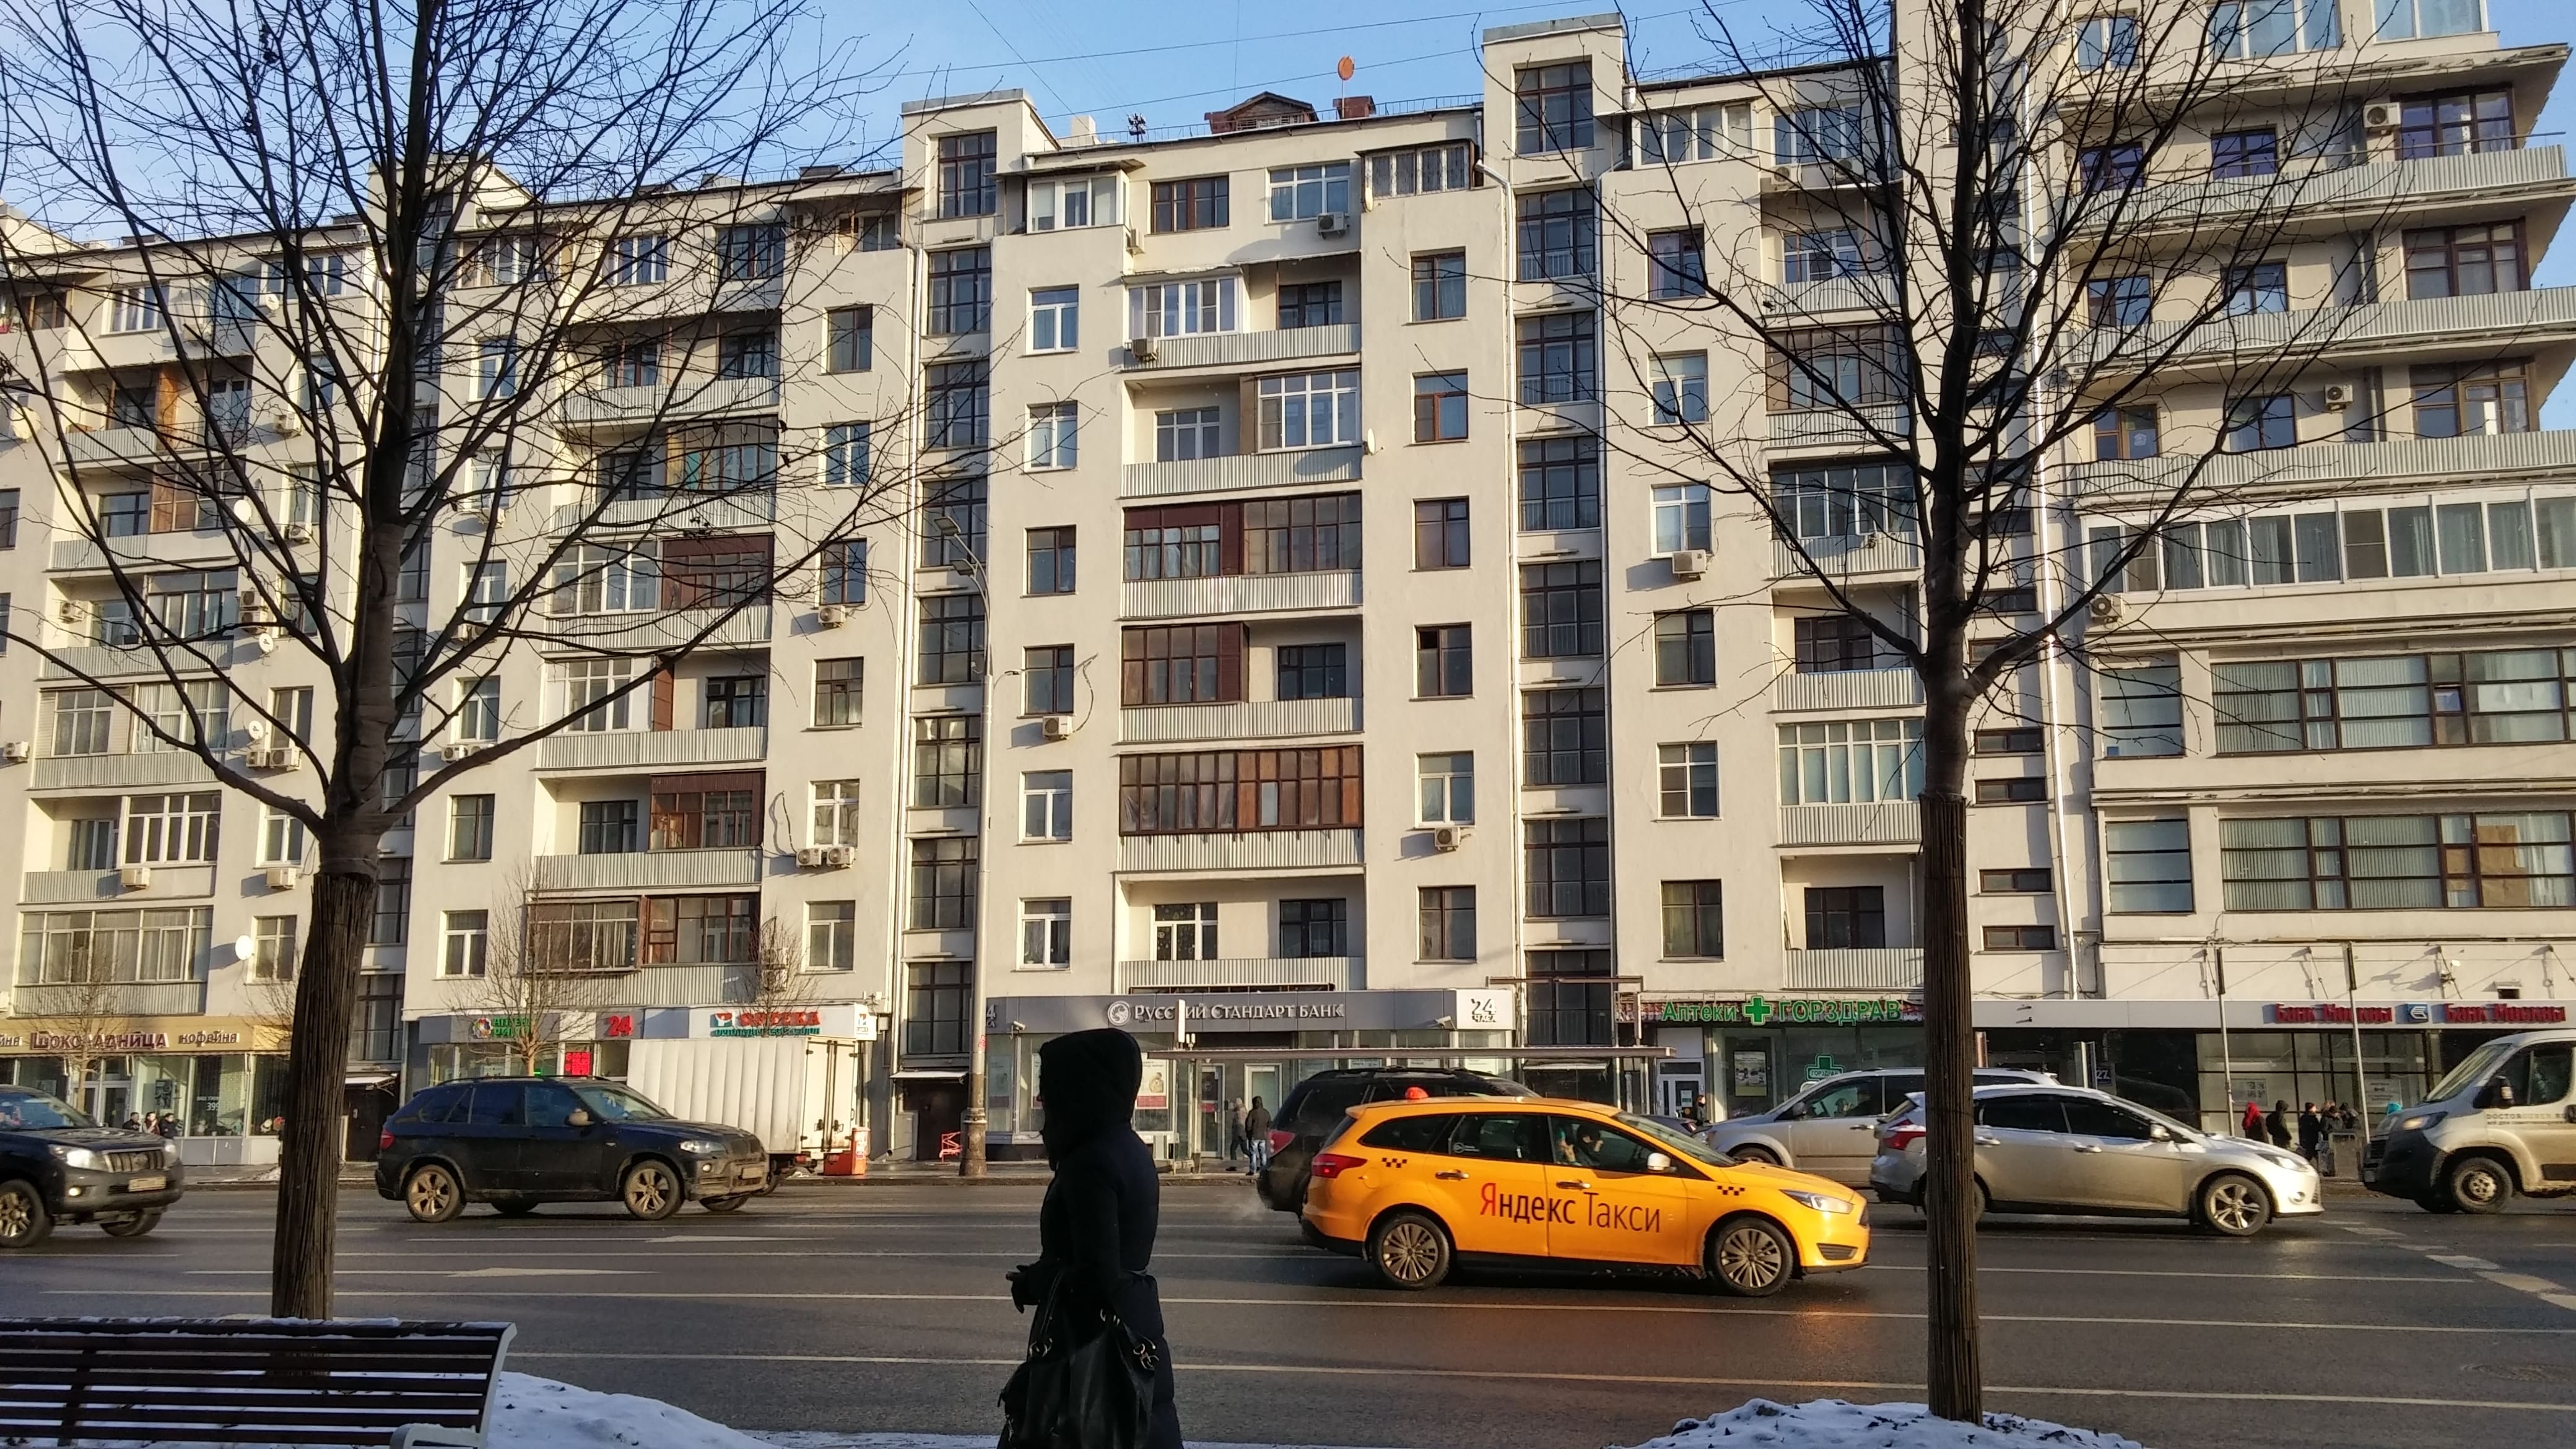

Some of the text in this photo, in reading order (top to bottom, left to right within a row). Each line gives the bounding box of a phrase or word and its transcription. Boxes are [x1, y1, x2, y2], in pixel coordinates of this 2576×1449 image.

[1134, 1003, 1207, 1022] РУССИЙ
[1299, 1004, 1345, 1018] БАНК
[1471, 998, 1497, 1015] 24
[1661, 999, 1902, 1026] Аптеки ГОРЗДРАВ
[608, 1014, 633, 1037] 24
[1479, 1182, 1661, 1234] Яндекс Такси
